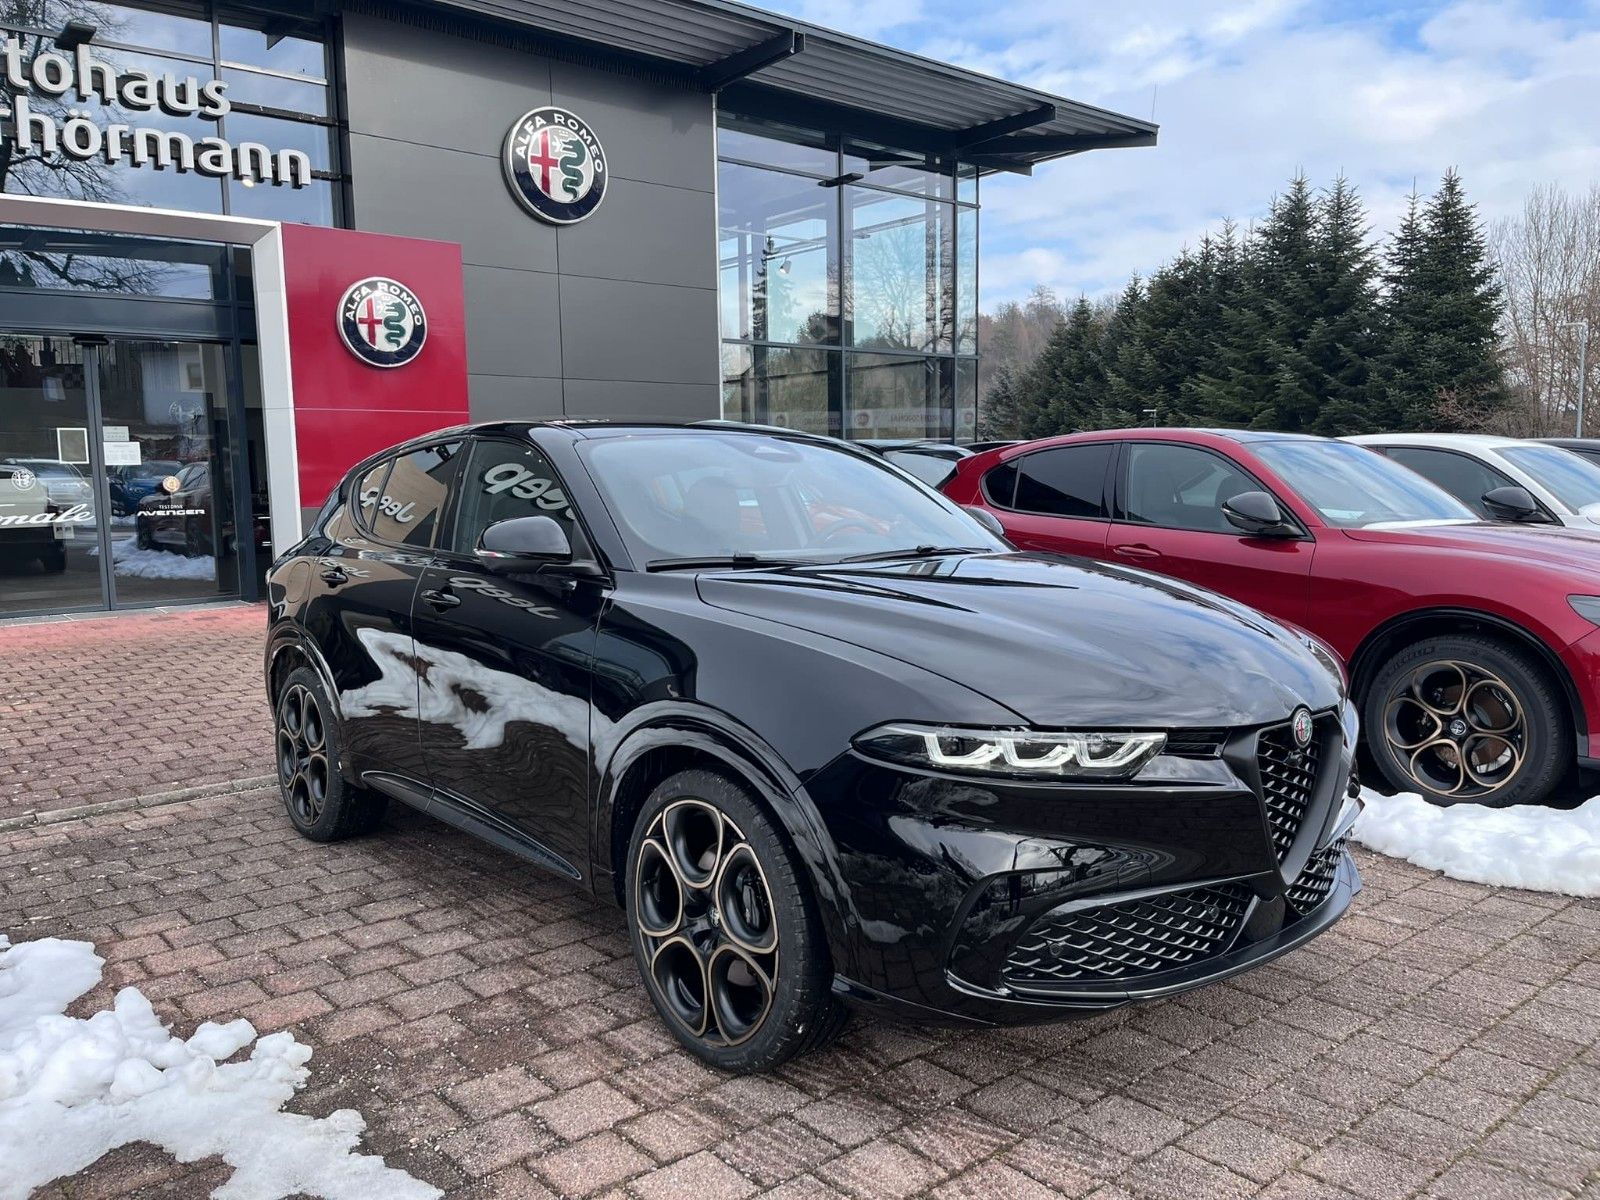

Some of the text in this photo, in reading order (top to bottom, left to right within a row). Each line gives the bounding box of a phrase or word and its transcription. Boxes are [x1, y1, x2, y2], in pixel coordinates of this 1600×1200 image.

[515, 113, 603, 173] ALFA ROMEO
[345, 281, 422, 326] ALFA ROMEO
[137, 509, 206, 517] AVENGER
